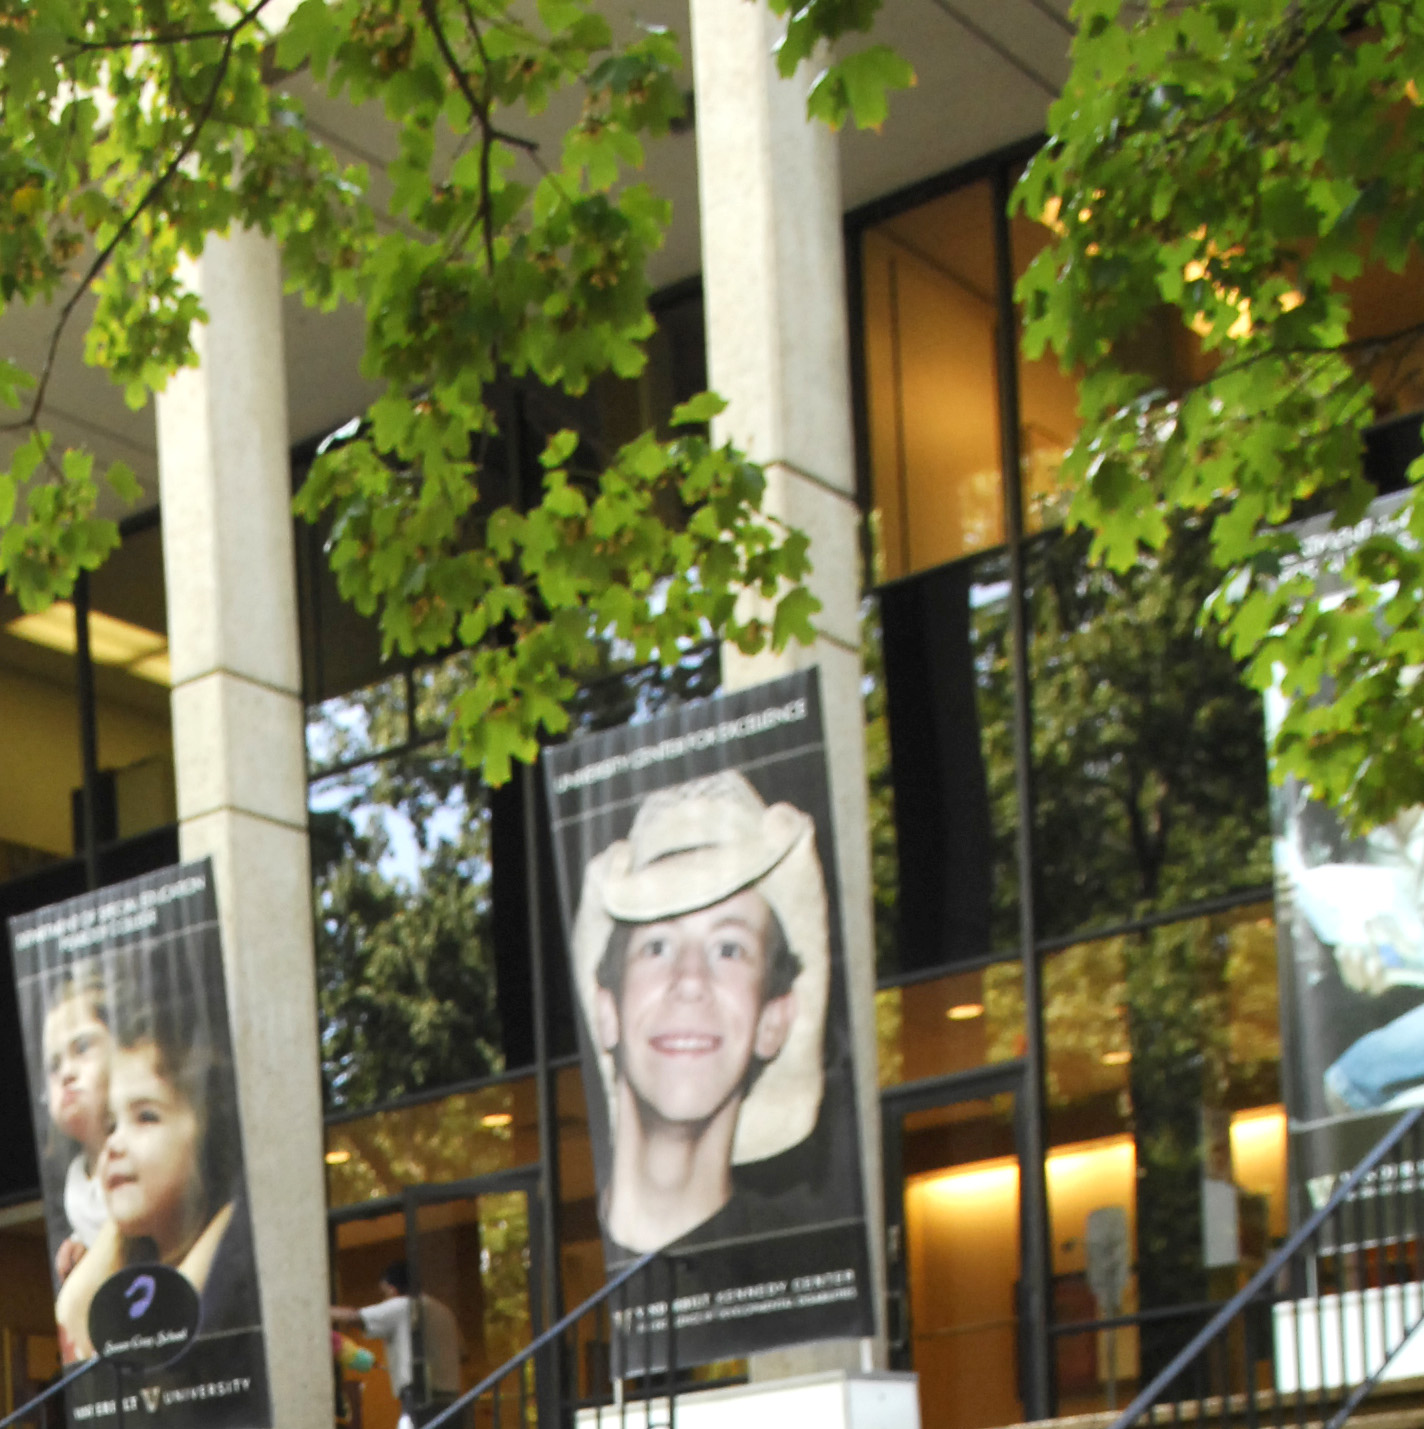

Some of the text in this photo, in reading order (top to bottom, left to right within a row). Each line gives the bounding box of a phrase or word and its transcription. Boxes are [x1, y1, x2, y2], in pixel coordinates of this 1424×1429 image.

[717, 697, 807, 742] EXCELLENCE
[714, 1280, 789, 1304] KENNEDY
[791, 1268, 856, 1292] CENTER
[162, 1378, 251, 1404] UNIVERSITY
